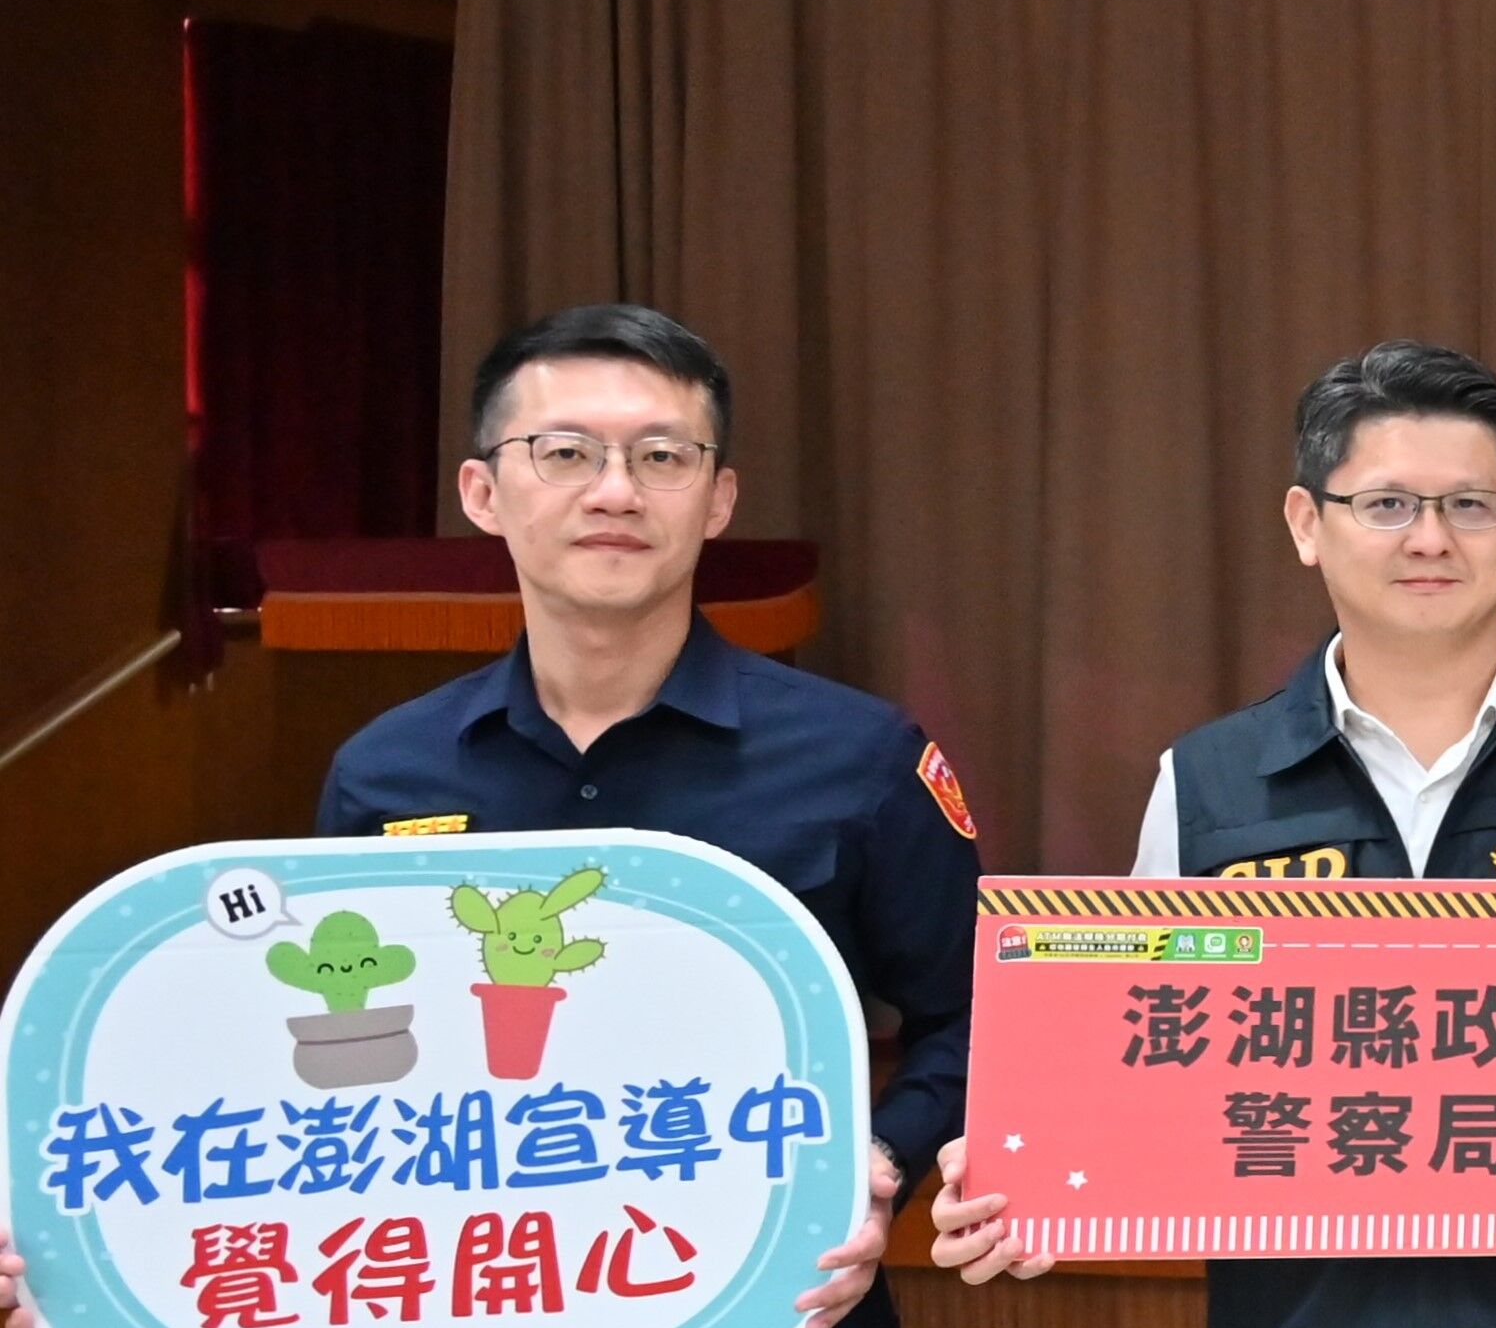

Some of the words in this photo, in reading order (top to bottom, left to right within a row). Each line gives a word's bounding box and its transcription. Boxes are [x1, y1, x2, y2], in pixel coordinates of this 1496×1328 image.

[219, 884, 266, 923] Hi
[47, 1073, 826, 1210] 我在澎湖宣導中
